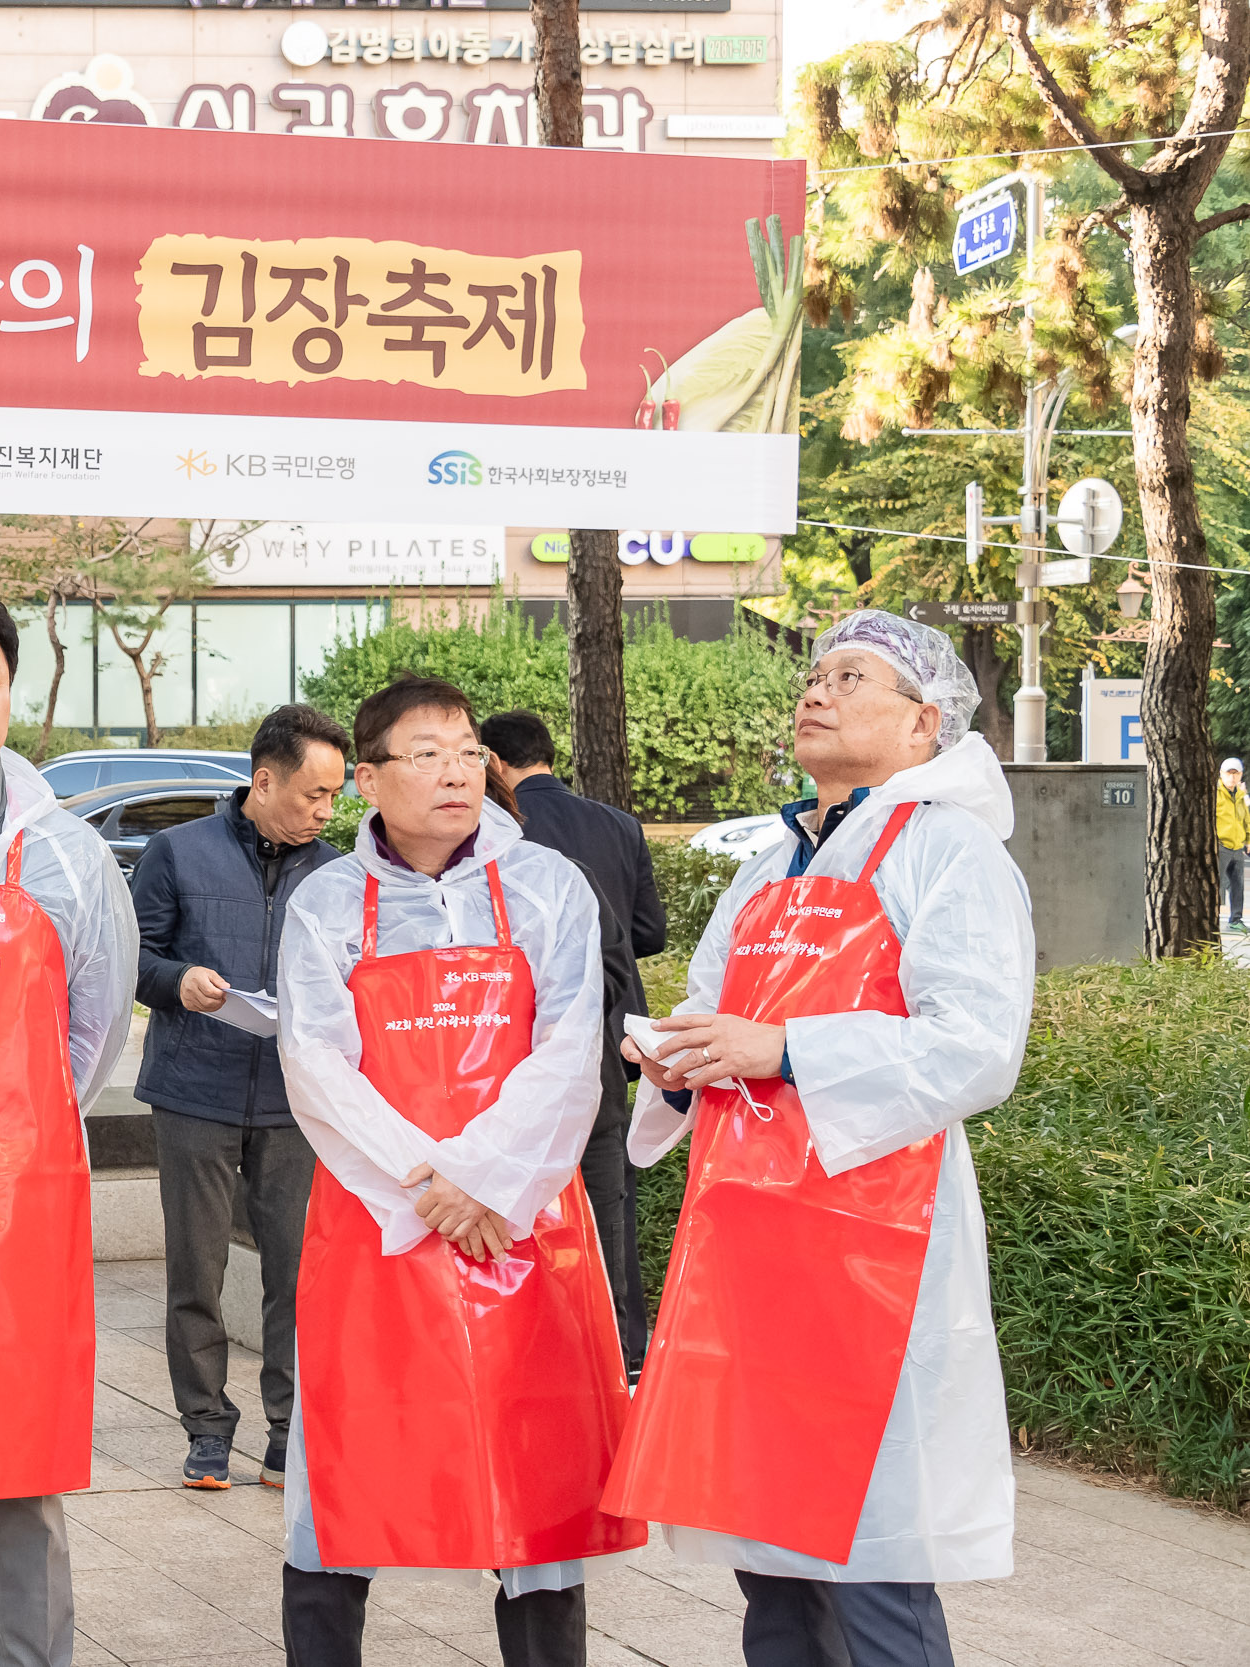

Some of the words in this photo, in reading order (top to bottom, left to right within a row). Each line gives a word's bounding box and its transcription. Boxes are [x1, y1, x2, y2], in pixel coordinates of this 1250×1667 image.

[709, 39, 764, 60] 2281-7975
[170, 251, 558, 380] 김장축제
[15, 470, 48, 479] Welfare
[51, 471, 101, 481] Foundation
[488, 466, 627, 488] 한국사회보장정보원
[262, 539, 332, 558] WHY
[617, 530, 684, 565] CU
[1114, 790, 1131, 804] 10
[769, 930, 786, 939] 2024
[433, 1003, 456, 1012] 2024
[385, 1019, 412, 1031] 제2회
[414, 1017, 435, 1029] 광진
[436, 1015, 470, 1028] 사랑의
[472, 1013, 511, 1027] 김장축제
